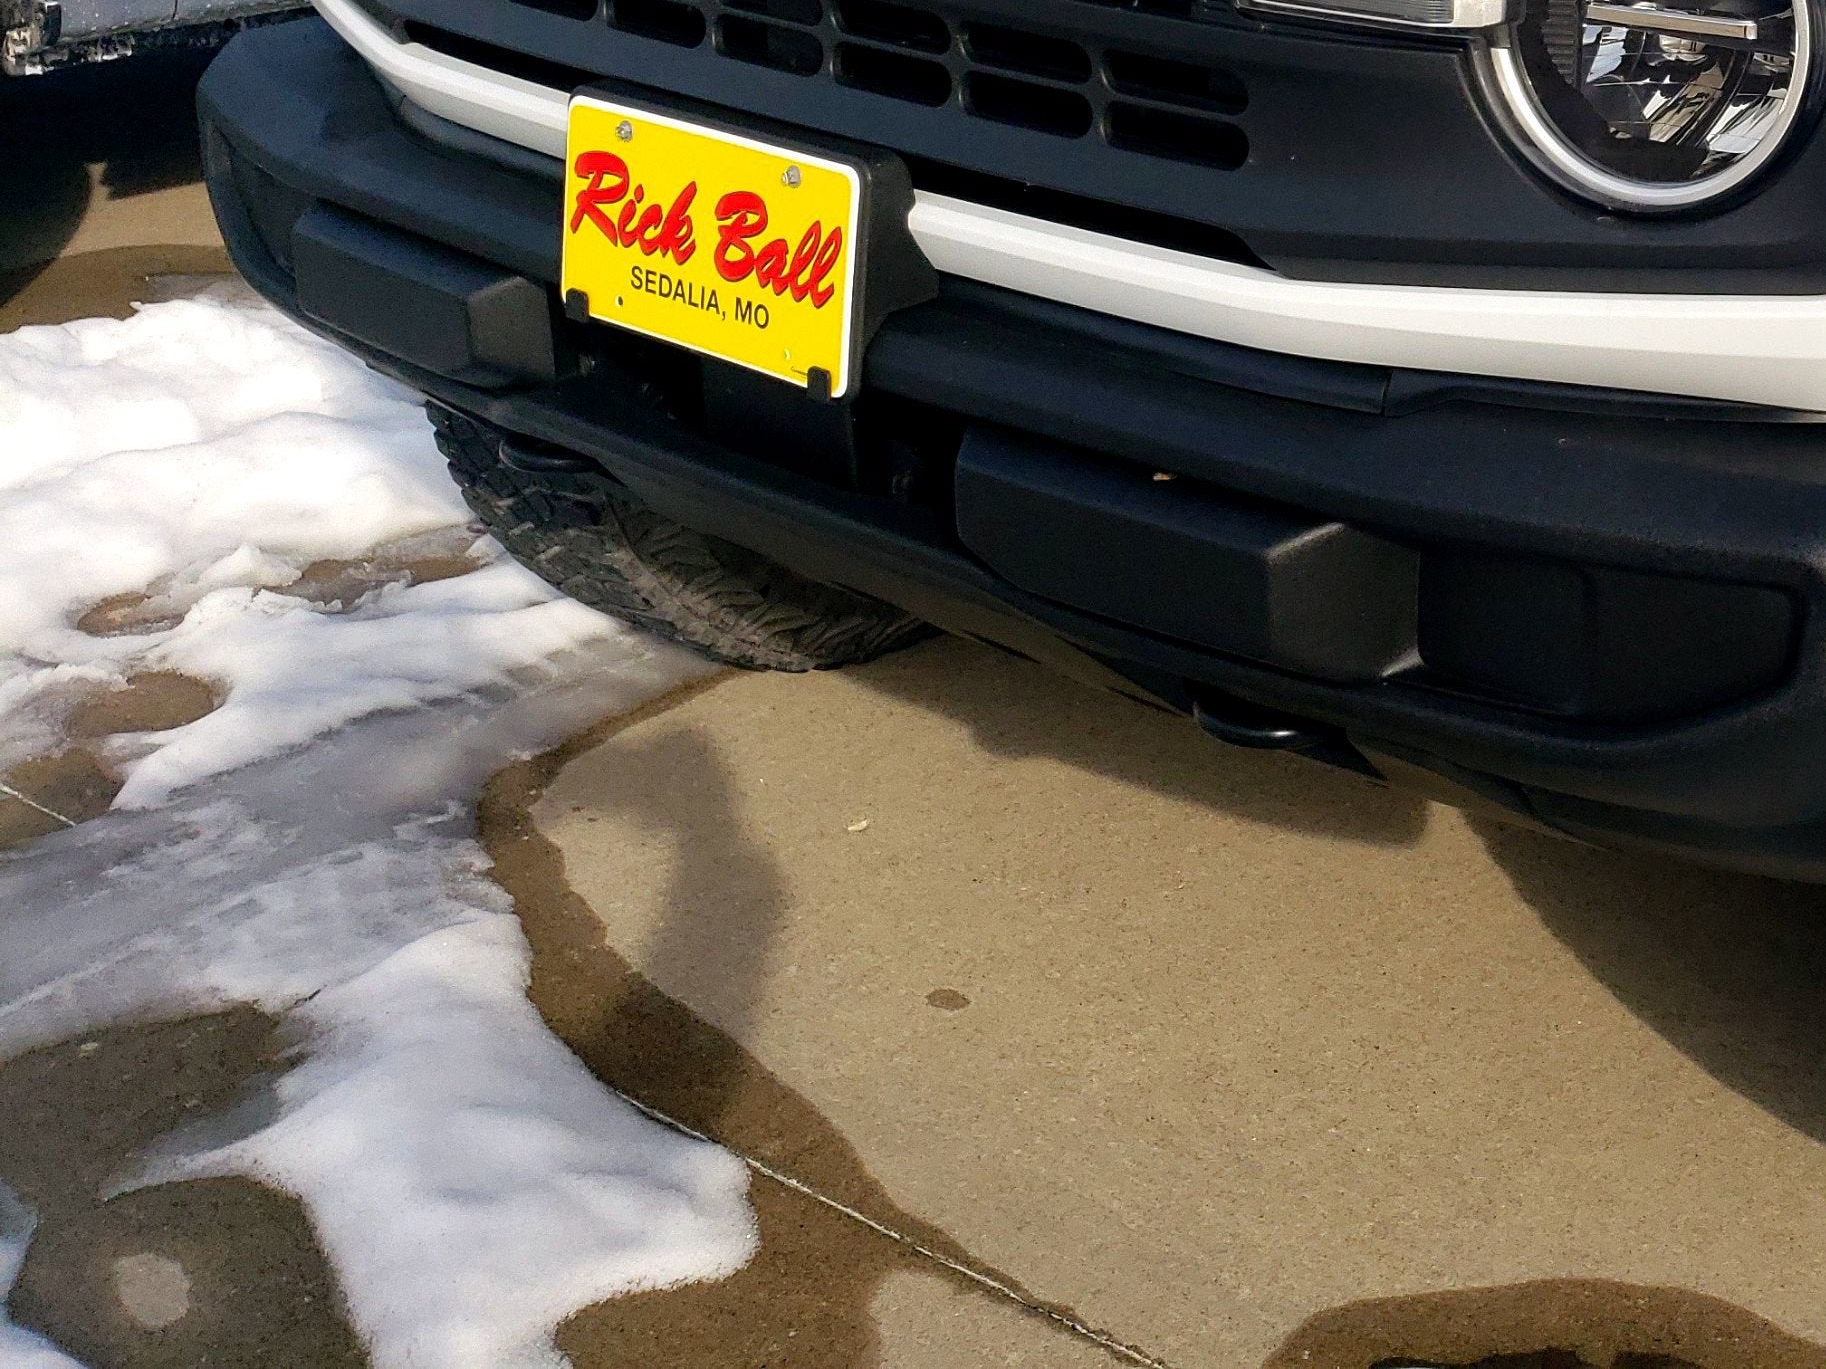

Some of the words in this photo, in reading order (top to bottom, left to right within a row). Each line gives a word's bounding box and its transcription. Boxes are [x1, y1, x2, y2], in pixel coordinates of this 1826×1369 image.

[570, 149, 697, 266] Rick
[712, 189, 843, 310] Ball
[629, 264, 727, 322] SEDALIA,
[734, 296, 770, 330] MO
